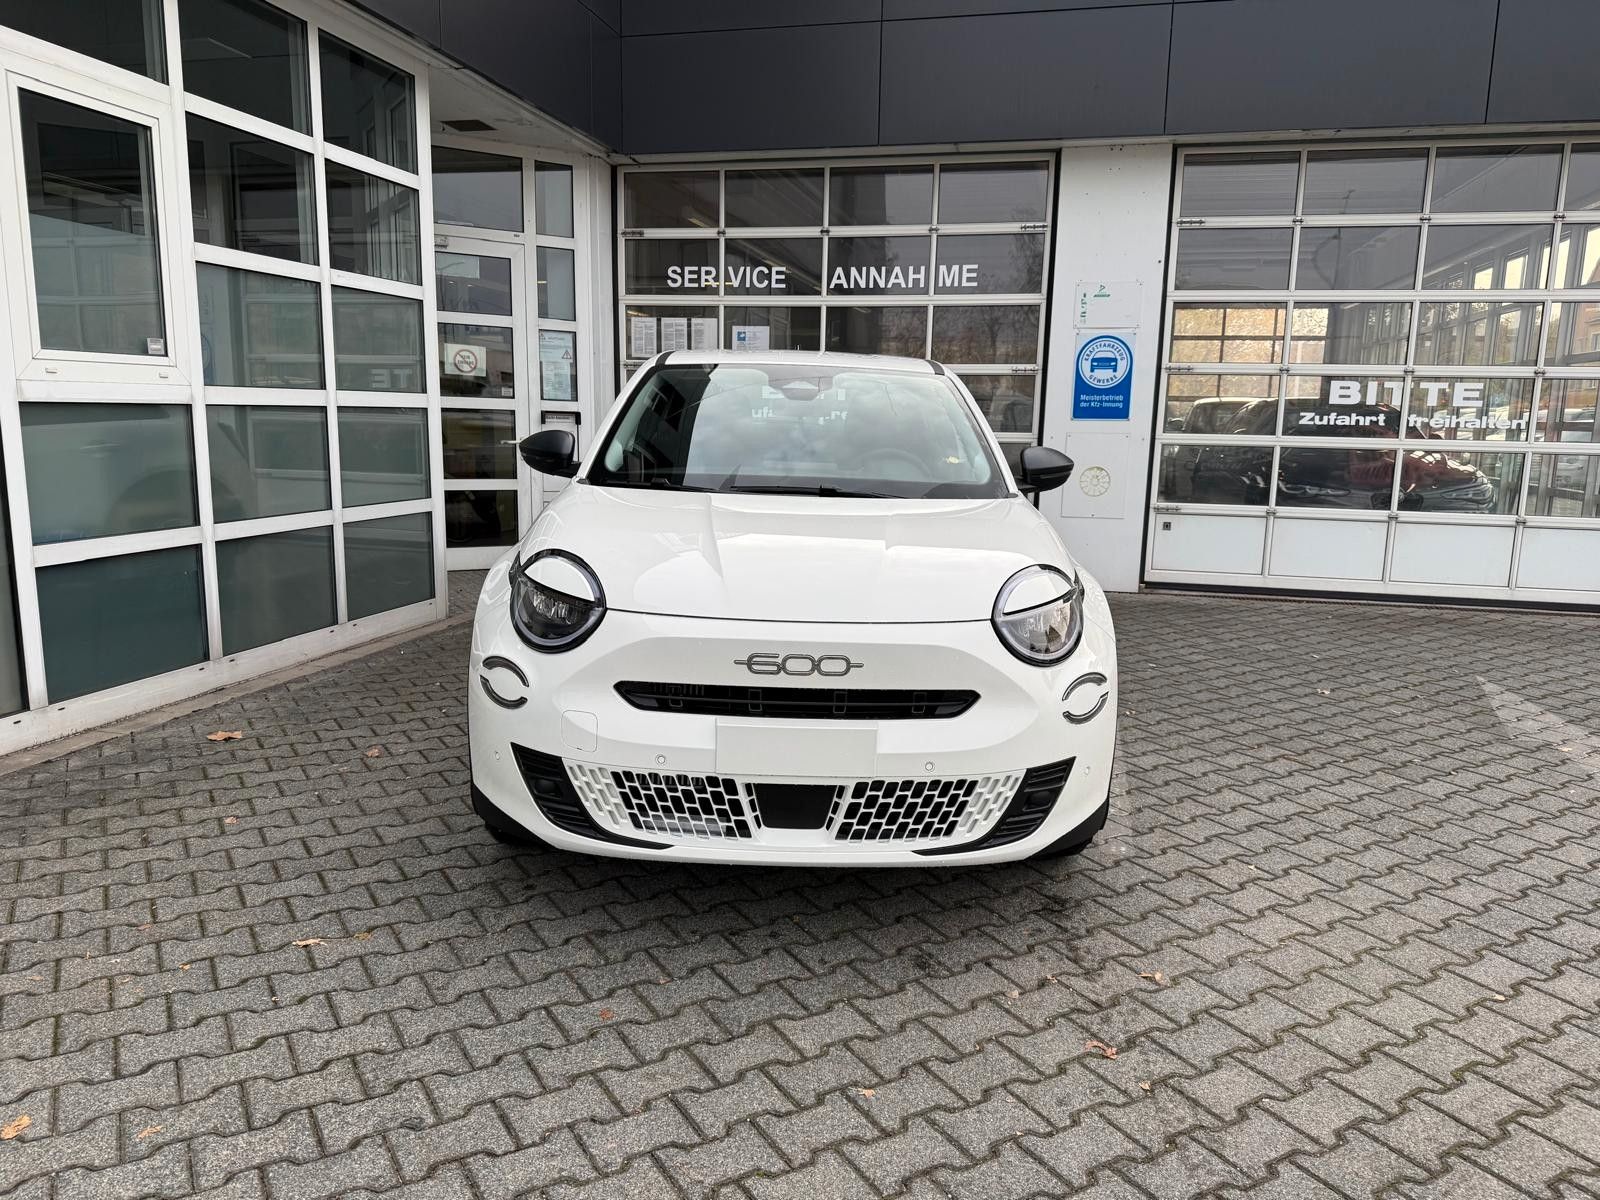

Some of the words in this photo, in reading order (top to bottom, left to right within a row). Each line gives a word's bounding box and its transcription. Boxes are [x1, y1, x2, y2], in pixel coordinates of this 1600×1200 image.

[666, 265, 787, 289] SERVICE
[829, 264, 979, 289] ANNAHME
[1090, 401, 1123, 409] Kfz-Innung
[1328, 380, 1484, 408] BITTE
[1298, 411, 1386, 427] Zufahrt
[1408, 414, 1528, 430] freihalten
